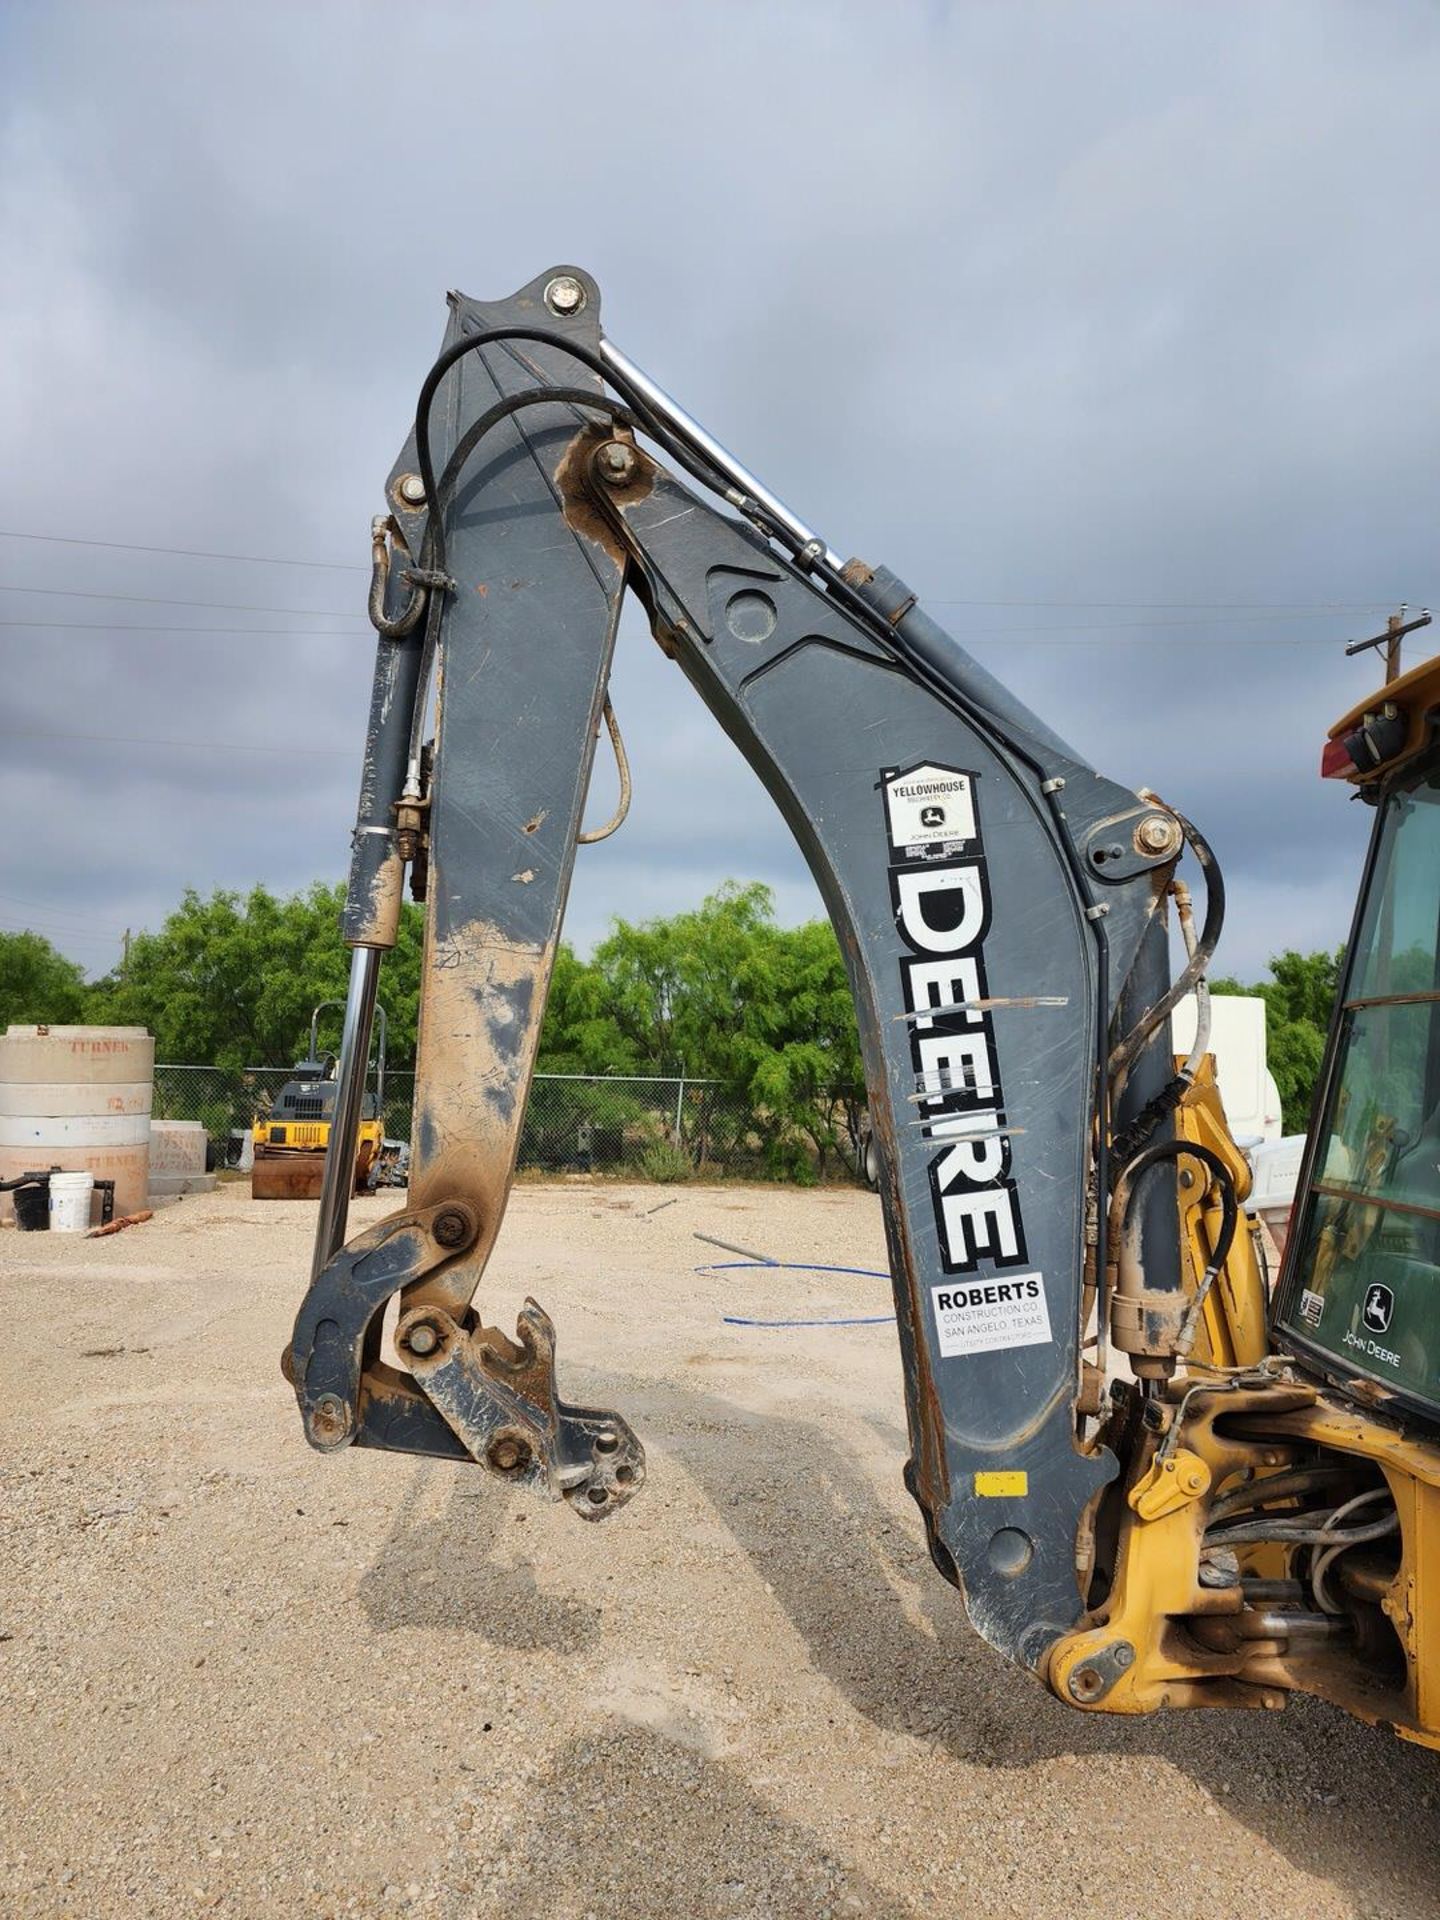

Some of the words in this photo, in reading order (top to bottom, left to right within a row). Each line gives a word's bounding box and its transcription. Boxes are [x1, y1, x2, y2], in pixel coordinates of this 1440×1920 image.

[893, 780, 966, 798] YELLOWHOUSE
[898, 866, 1019, 1264] DEERE
[938, 1280, 1039, 1311] ROBERTS
[943, 1306, 1021, 1324] CONSTRUCTION
[944, 1327, 965, 1338] SAN
[1012, 1314, 1044, 1328] TEXAS
[1342, 1329, 1367, 1351] JOHN
[1367, 1340, 1401, 1368] DEERE
